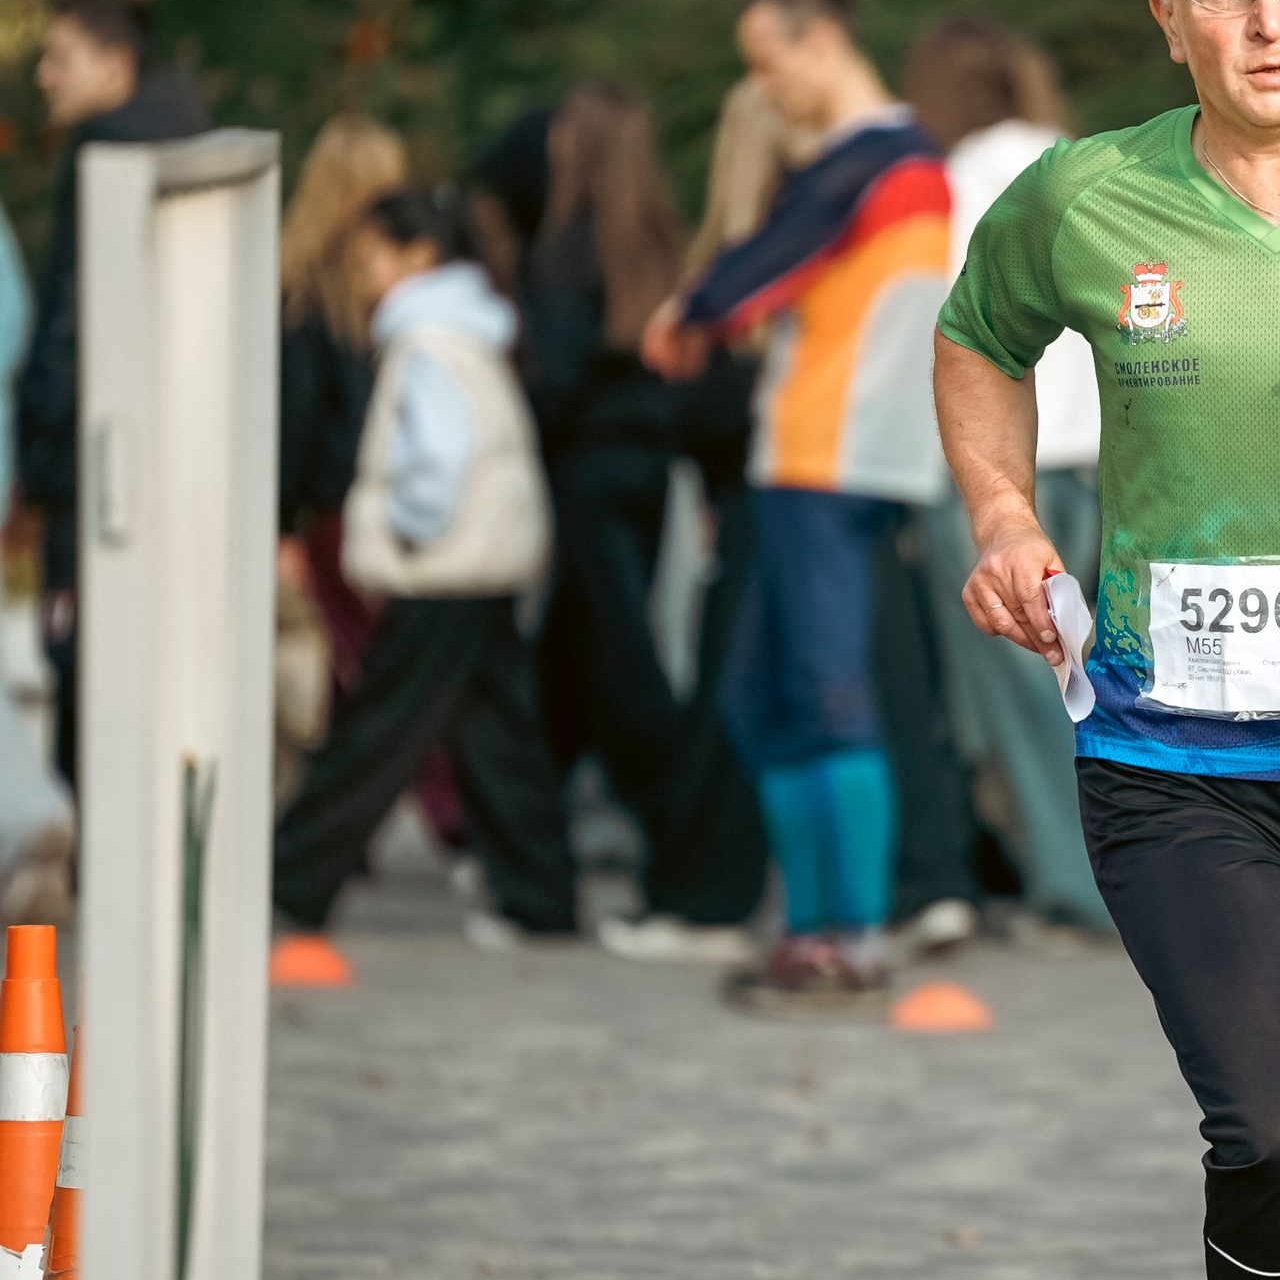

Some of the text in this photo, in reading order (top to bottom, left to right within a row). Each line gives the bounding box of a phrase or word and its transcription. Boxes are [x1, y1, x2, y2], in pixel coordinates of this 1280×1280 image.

[1114, 358, 1200, 375] СМОЛЕНСКОЕ
[1117, 375, 1201, 388] ОРИЕНТИРОВАНИЕ
[1186, 636, 1223, 656] M55
